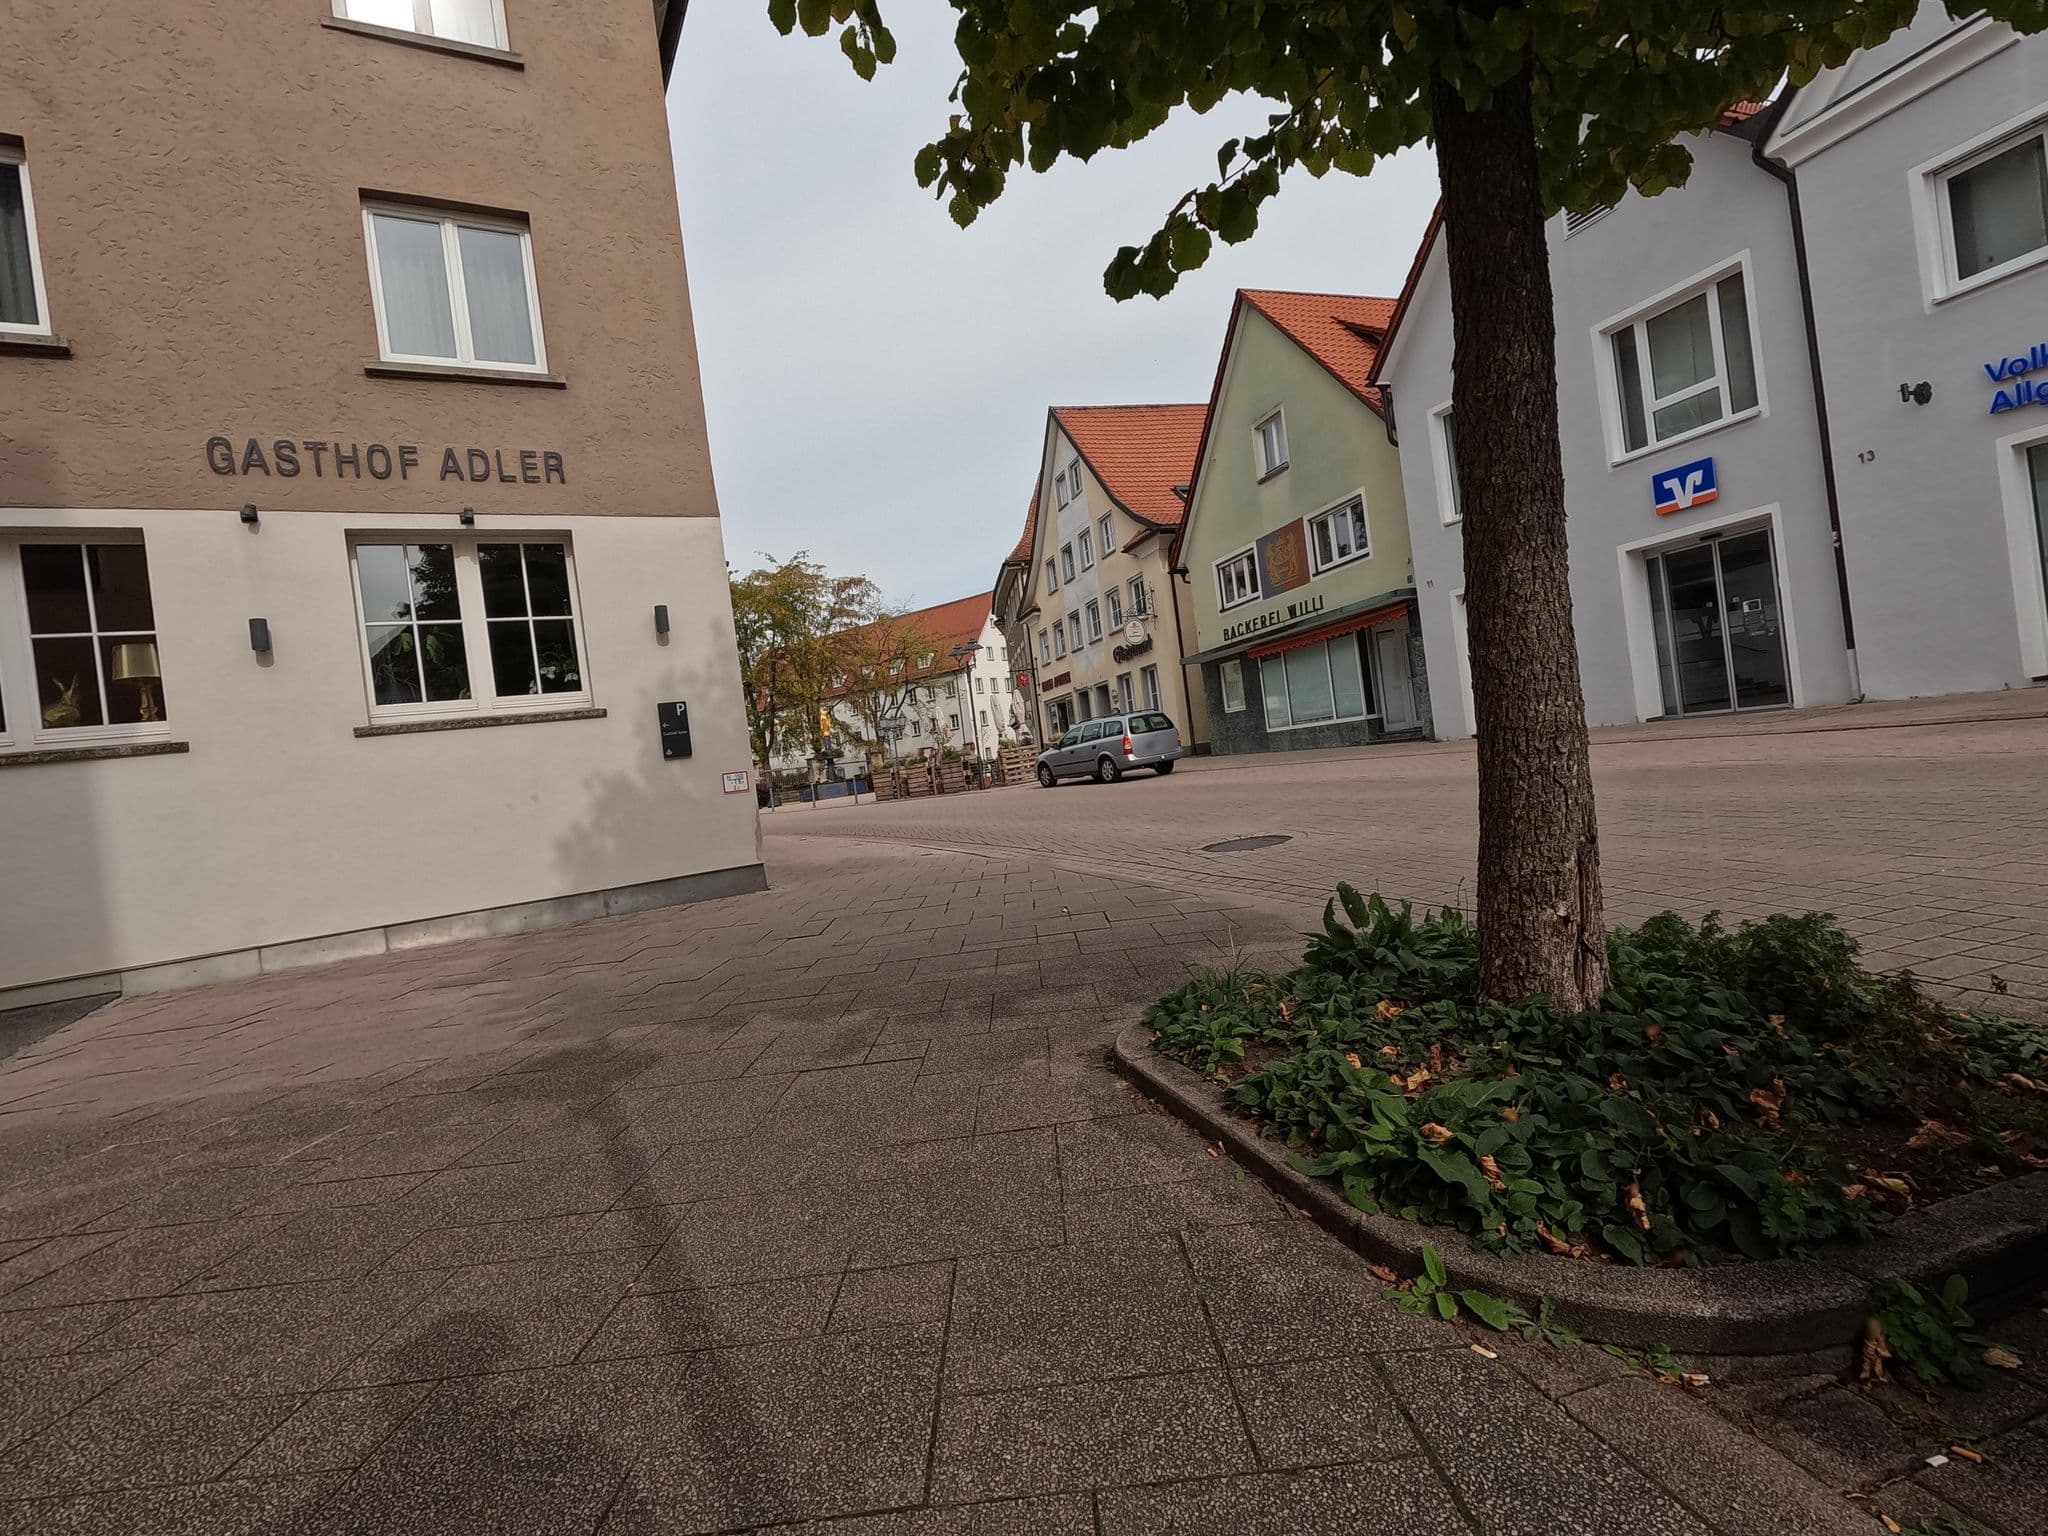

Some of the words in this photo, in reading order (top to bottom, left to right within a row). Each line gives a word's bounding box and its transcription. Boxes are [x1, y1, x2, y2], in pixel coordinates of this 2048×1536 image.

[205, 435, 419, 481] GASTHOF
[440, 447, 567, 485] ADLER
[1857, 449, 1876, 464] 13
[1286, 594, 1325, 619] WILLI
[676, 702, 686, 716] P
